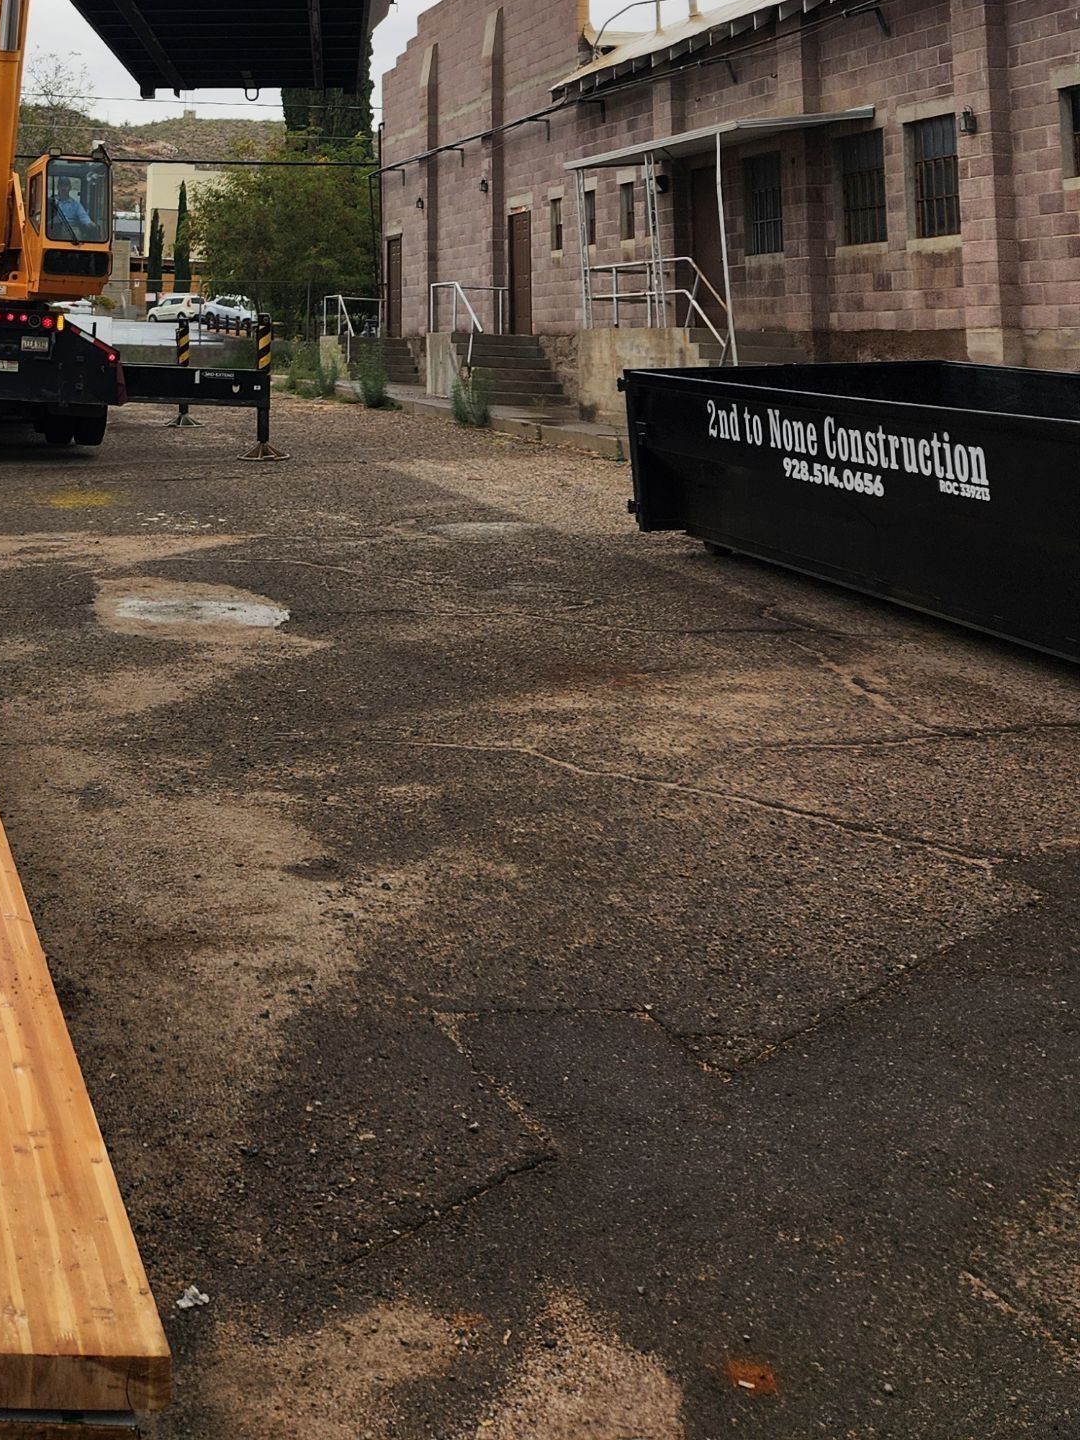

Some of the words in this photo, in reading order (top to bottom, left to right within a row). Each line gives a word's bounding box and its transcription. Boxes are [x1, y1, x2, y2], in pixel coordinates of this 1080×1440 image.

[707, 399, 740, 442] 2nd
[744, 407, 763, 446] to
[767, 408, 818, 456] None
[824, 416, 989, 485] Construction
[783, 457, 885, 496] 928.514.0656
[939, 479, 960, 496] ROC
